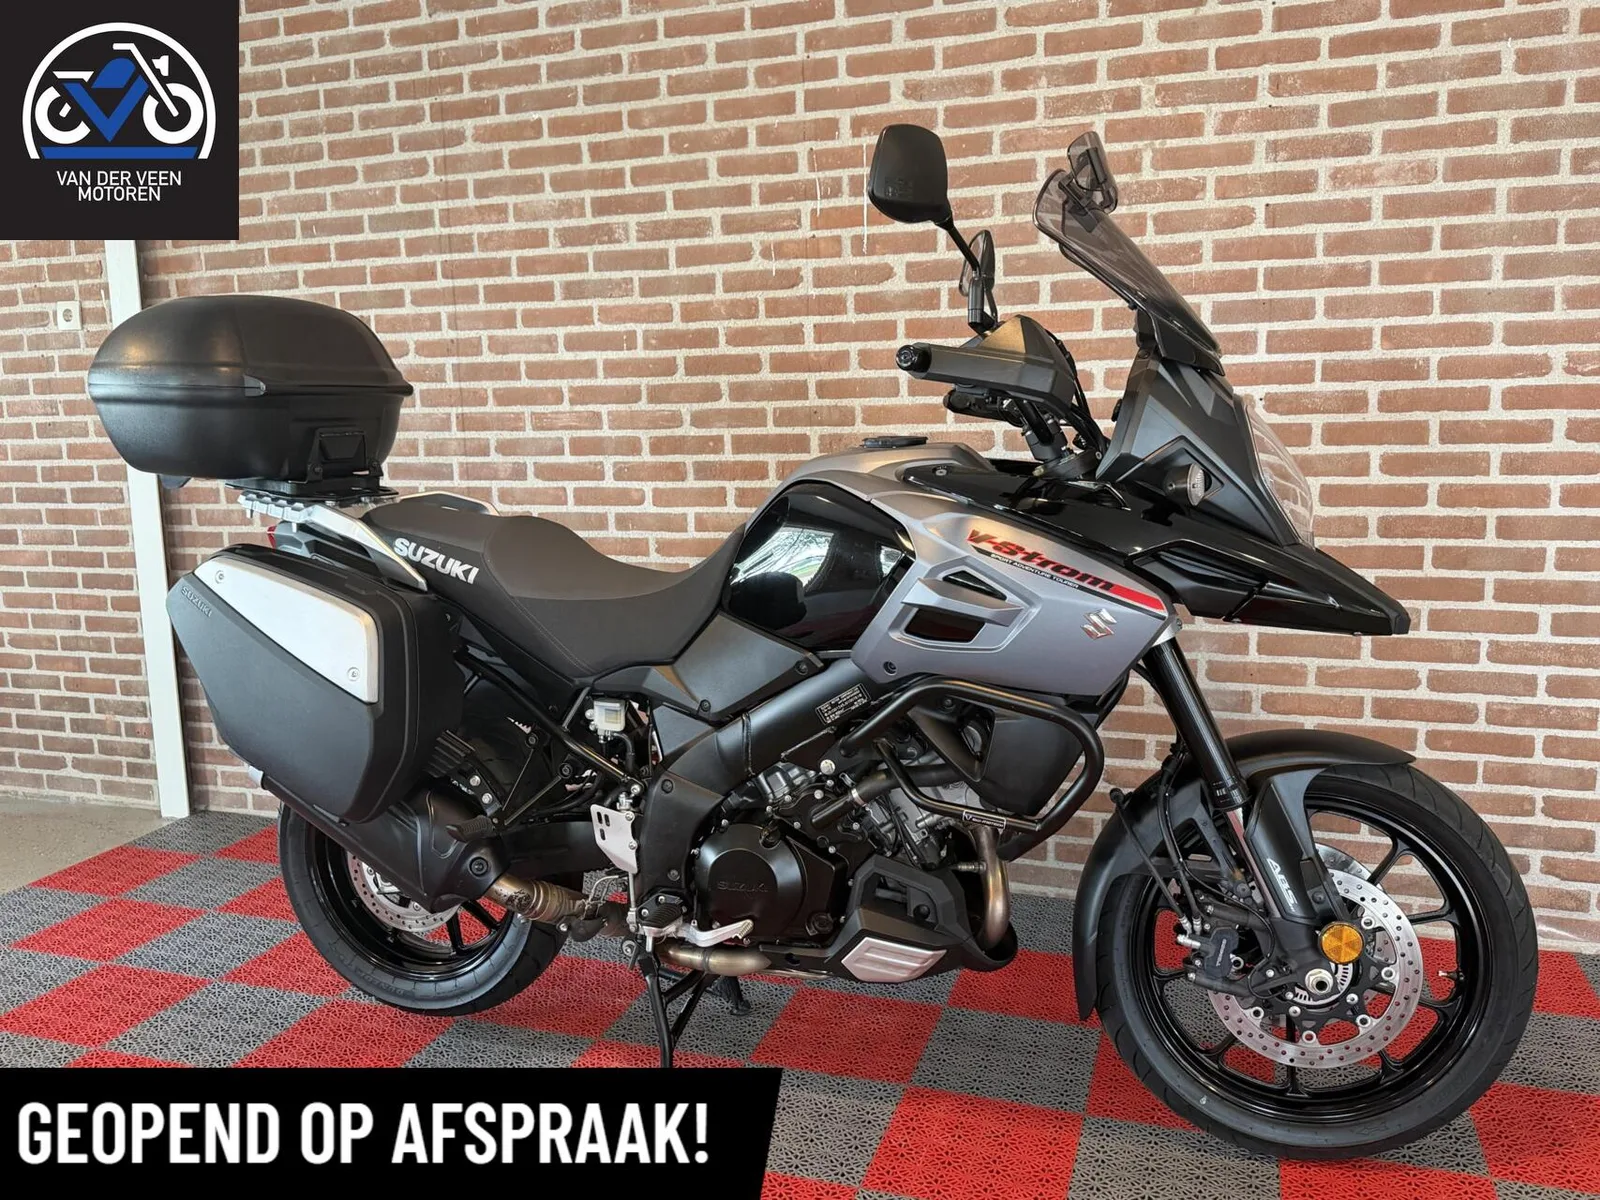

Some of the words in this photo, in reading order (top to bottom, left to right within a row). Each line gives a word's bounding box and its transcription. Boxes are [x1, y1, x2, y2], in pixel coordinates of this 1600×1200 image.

[394, 537, 479, 584] SUZUKI
[966, 529, 1113, 591] V-Strom
[990, 553, 1012, 565] SPORT
[1013, 561, 1052, 579] ADVENTURE
[1052, 575, 1079, 588] TOURER
[181, 586, 212, 617] SUZUKI
[1266, 858, 1298, 910] ABS
